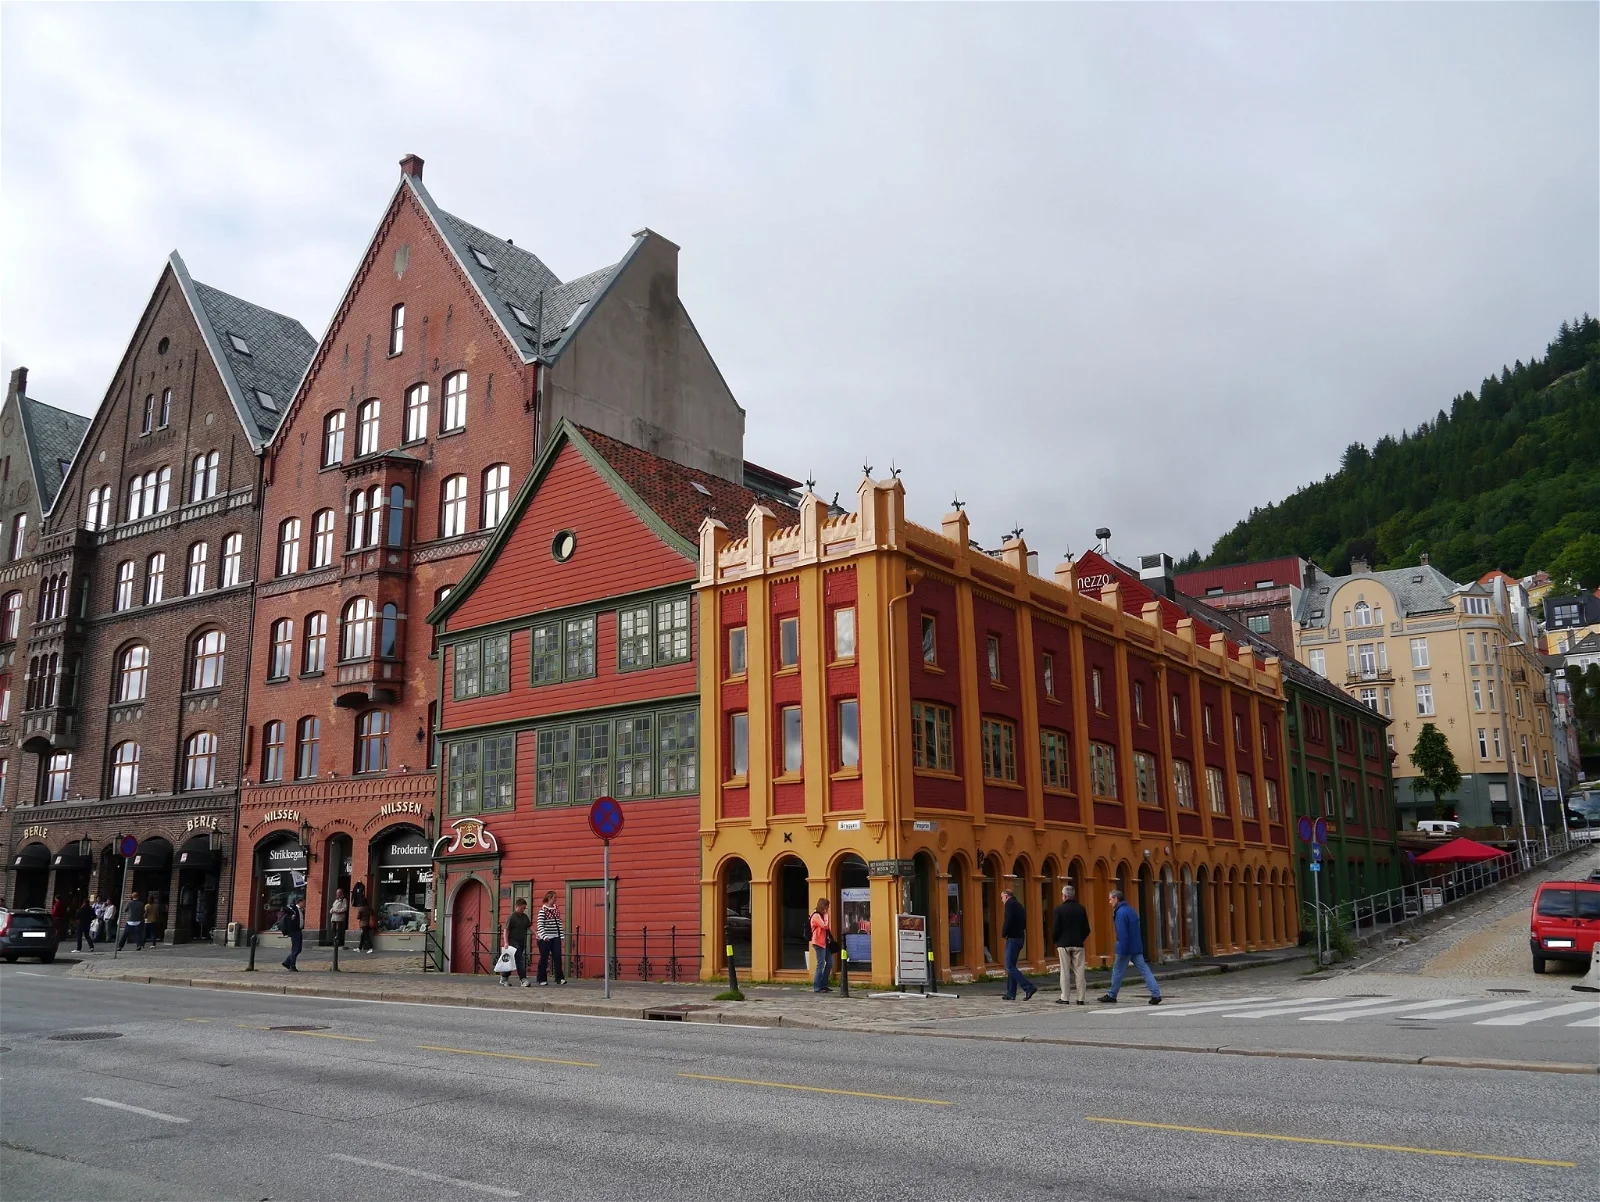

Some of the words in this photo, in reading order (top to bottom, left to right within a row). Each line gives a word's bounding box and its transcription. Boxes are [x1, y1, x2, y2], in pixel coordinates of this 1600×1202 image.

[381, 801, 422, 816] NILSSEN
[187, 815, 219, 831] BERLE
[264, 809, 300, 824] NILSSEN
[24, 825, 48, 839] BERLE
[391, 844, 428, 855] Broderier
